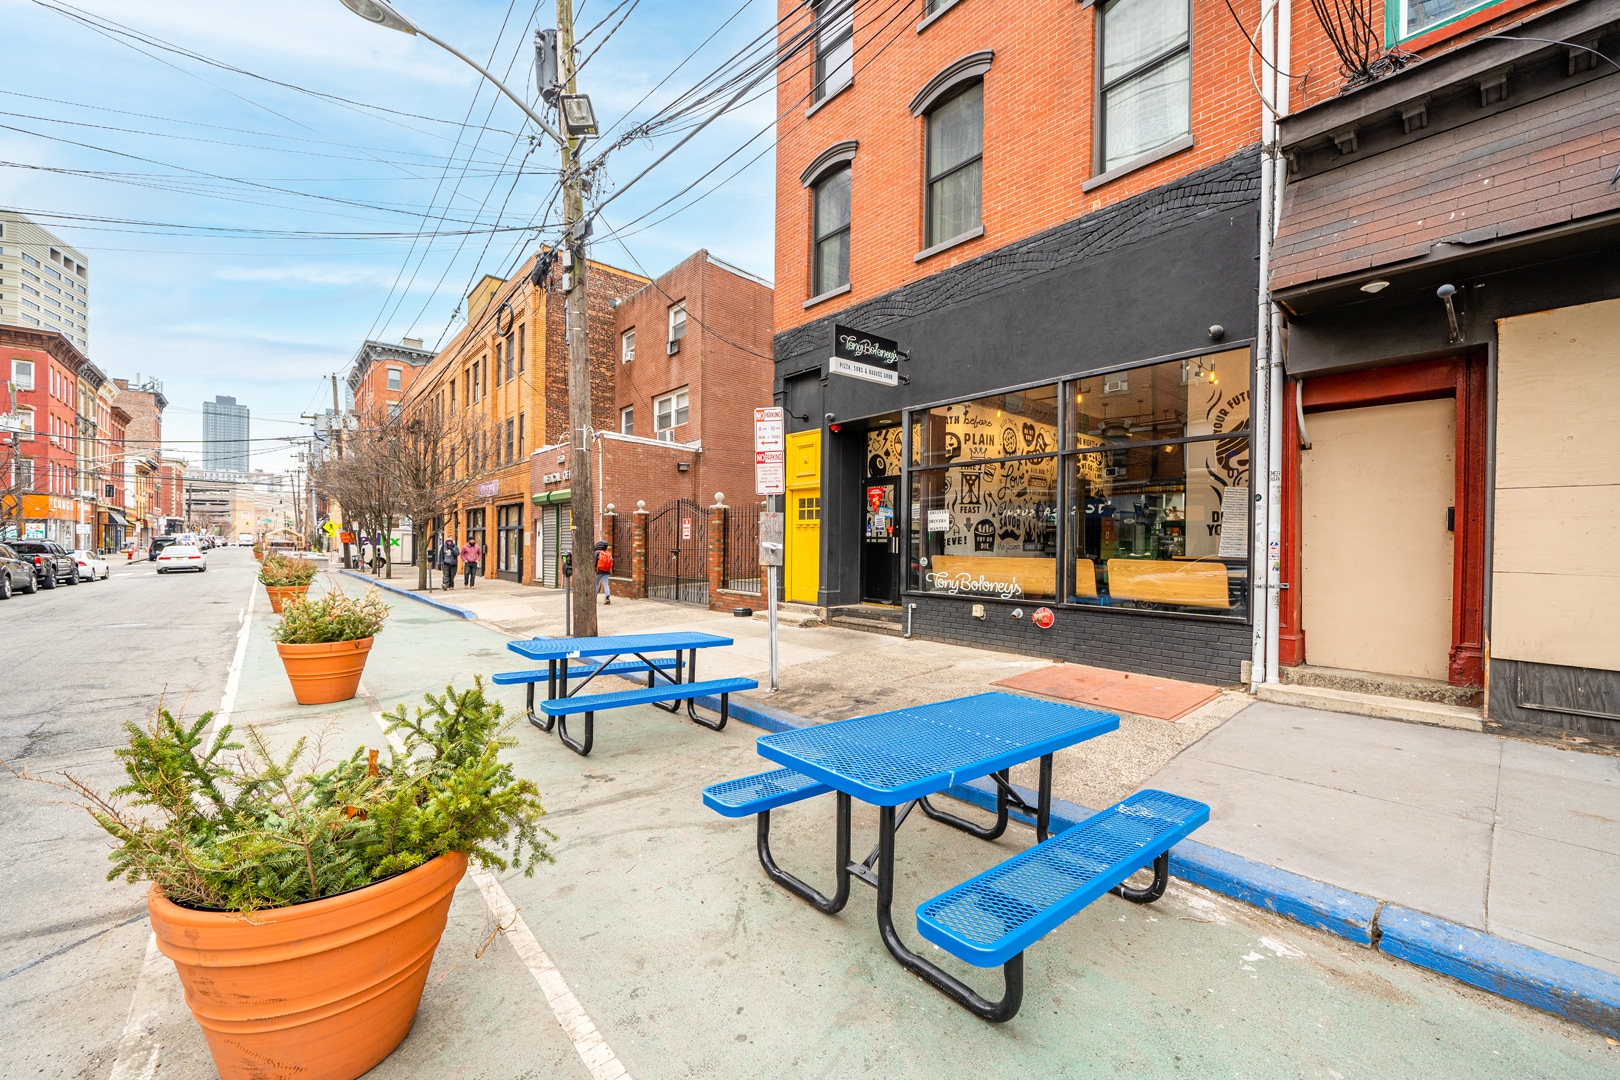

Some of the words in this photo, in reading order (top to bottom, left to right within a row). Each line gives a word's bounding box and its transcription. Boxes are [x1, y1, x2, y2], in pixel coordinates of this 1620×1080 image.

[840, 334, 863, 356] Tony
[860, 339, 898, 363] Boloney's
[756, 411, 764, 420] NO
[764, 410, 782, 418] PARKING
[963, 415, 992, 428] before
[1213, 408, 1230, 434] YOUR
[964, 433, 995, 446] PLAIN
[756, 453, 765, 462] NO
[765, 452, 783, 461] PARKING
[997, 464, 1025, 500] Love
[960, 506, 981, 514] FEAST
[999, 514, 1021, 530] SAVOR
[926, 571, 960, 595] Tony
[955, 572, 1022, 599] Boloney's
